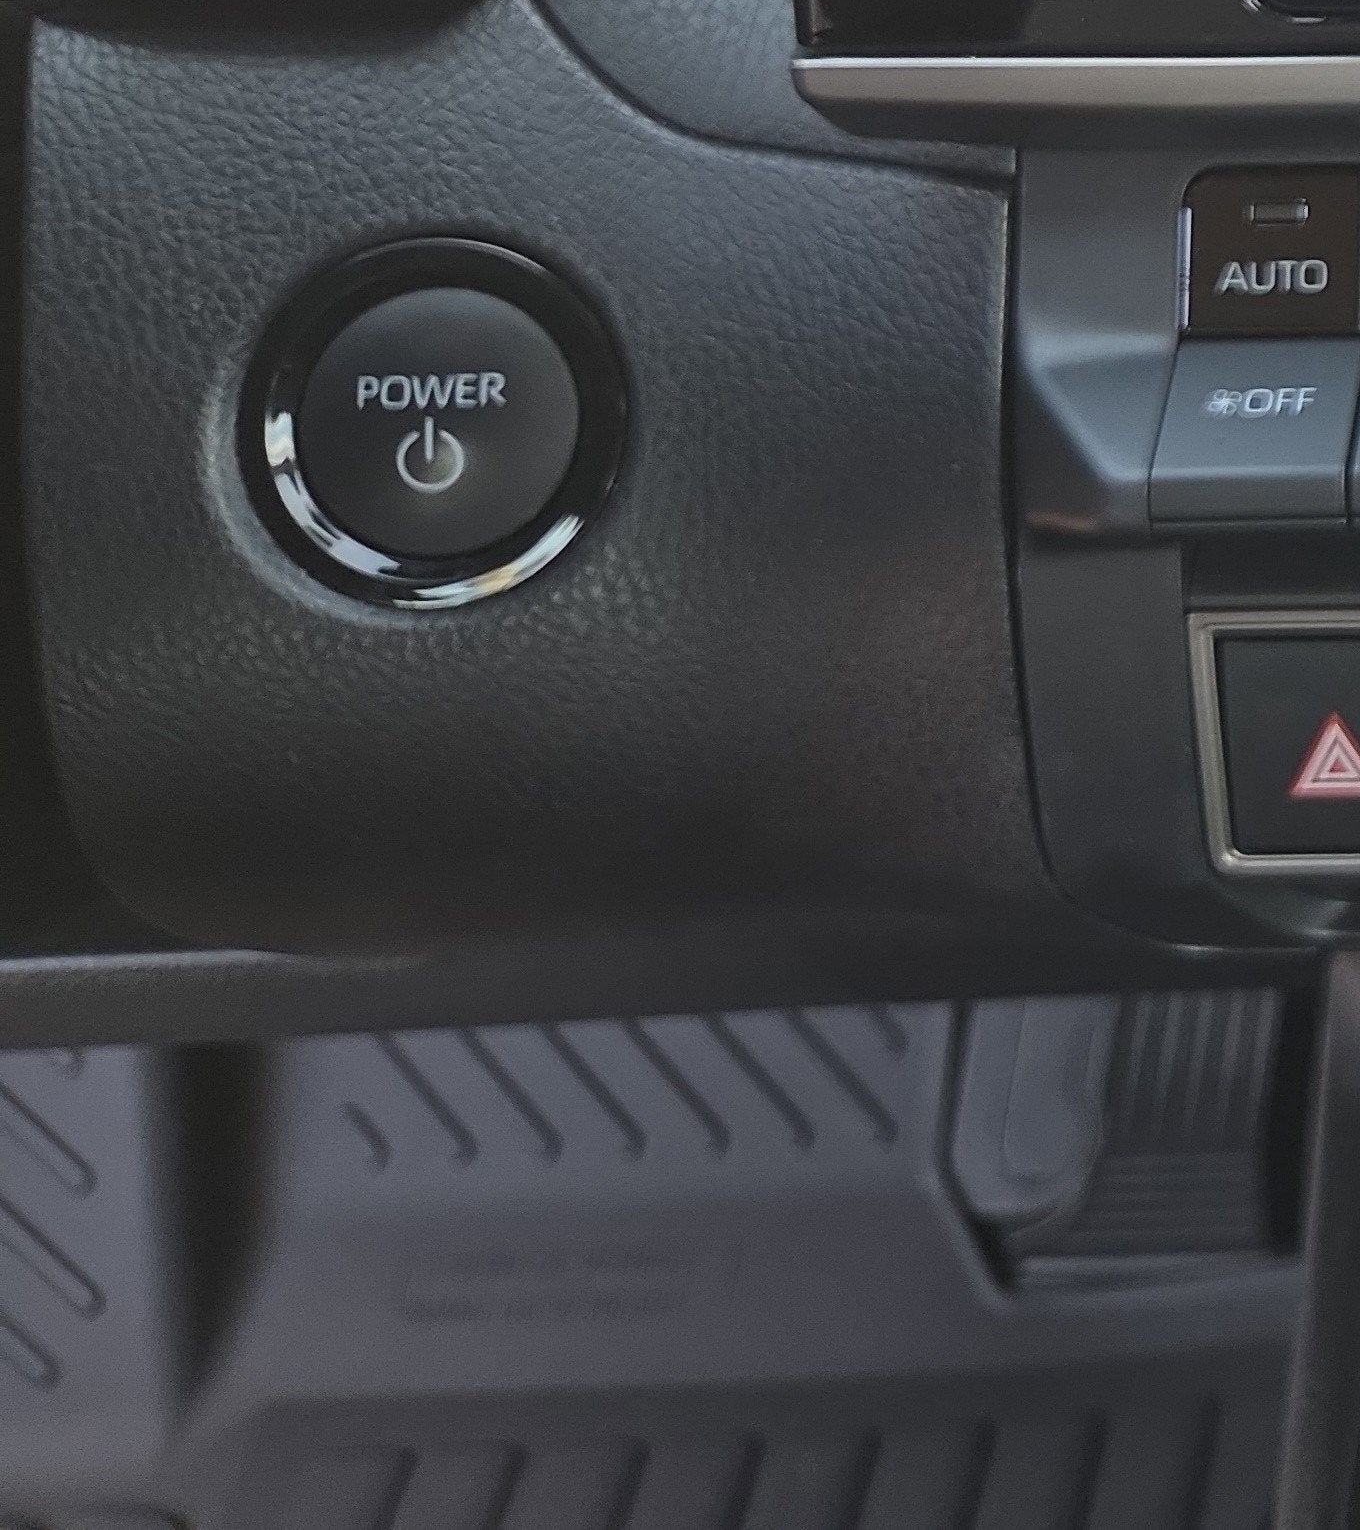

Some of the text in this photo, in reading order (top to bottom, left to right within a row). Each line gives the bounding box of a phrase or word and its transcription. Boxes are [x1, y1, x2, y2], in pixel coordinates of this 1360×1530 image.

[1217, 260, 1328, 293] AUTO
[357, 372, 507, 409] POWER
[1243, 388, 1316, 415] OFF
